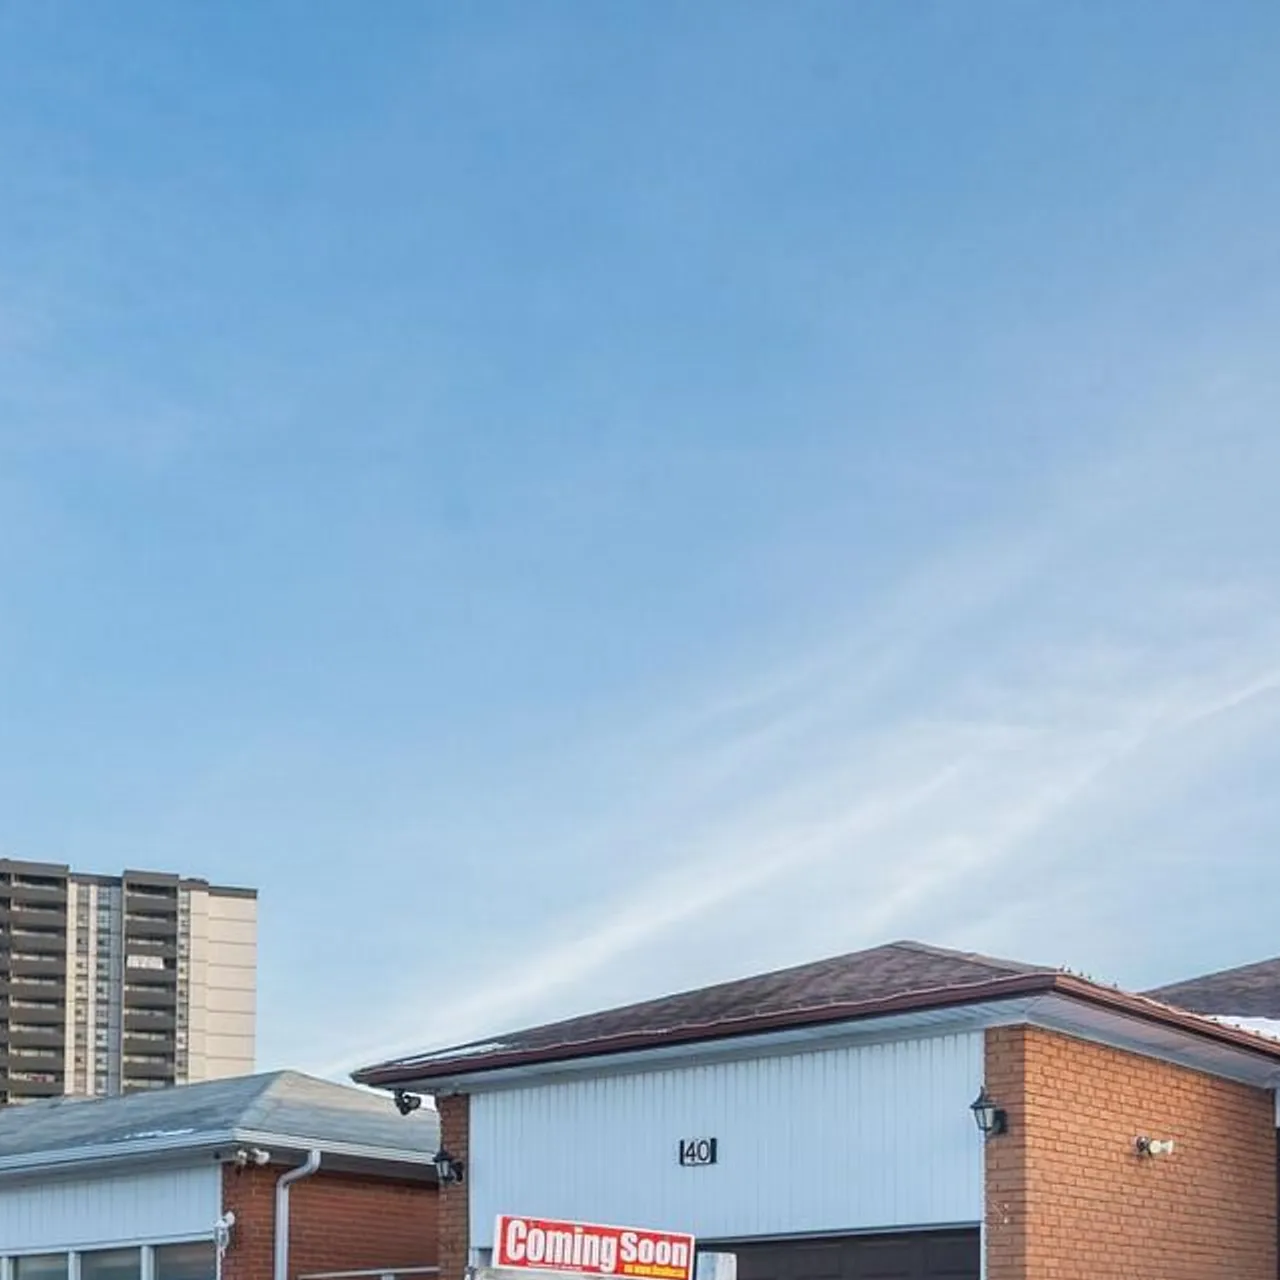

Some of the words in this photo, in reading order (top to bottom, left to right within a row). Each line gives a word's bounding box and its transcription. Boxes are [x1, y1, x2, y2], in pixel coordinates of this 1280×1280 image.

[685, 1139, 710, 1162] 40
[506, 1219, 618, 1273] Coming
[620, 1232, 688, 1268] Soon
